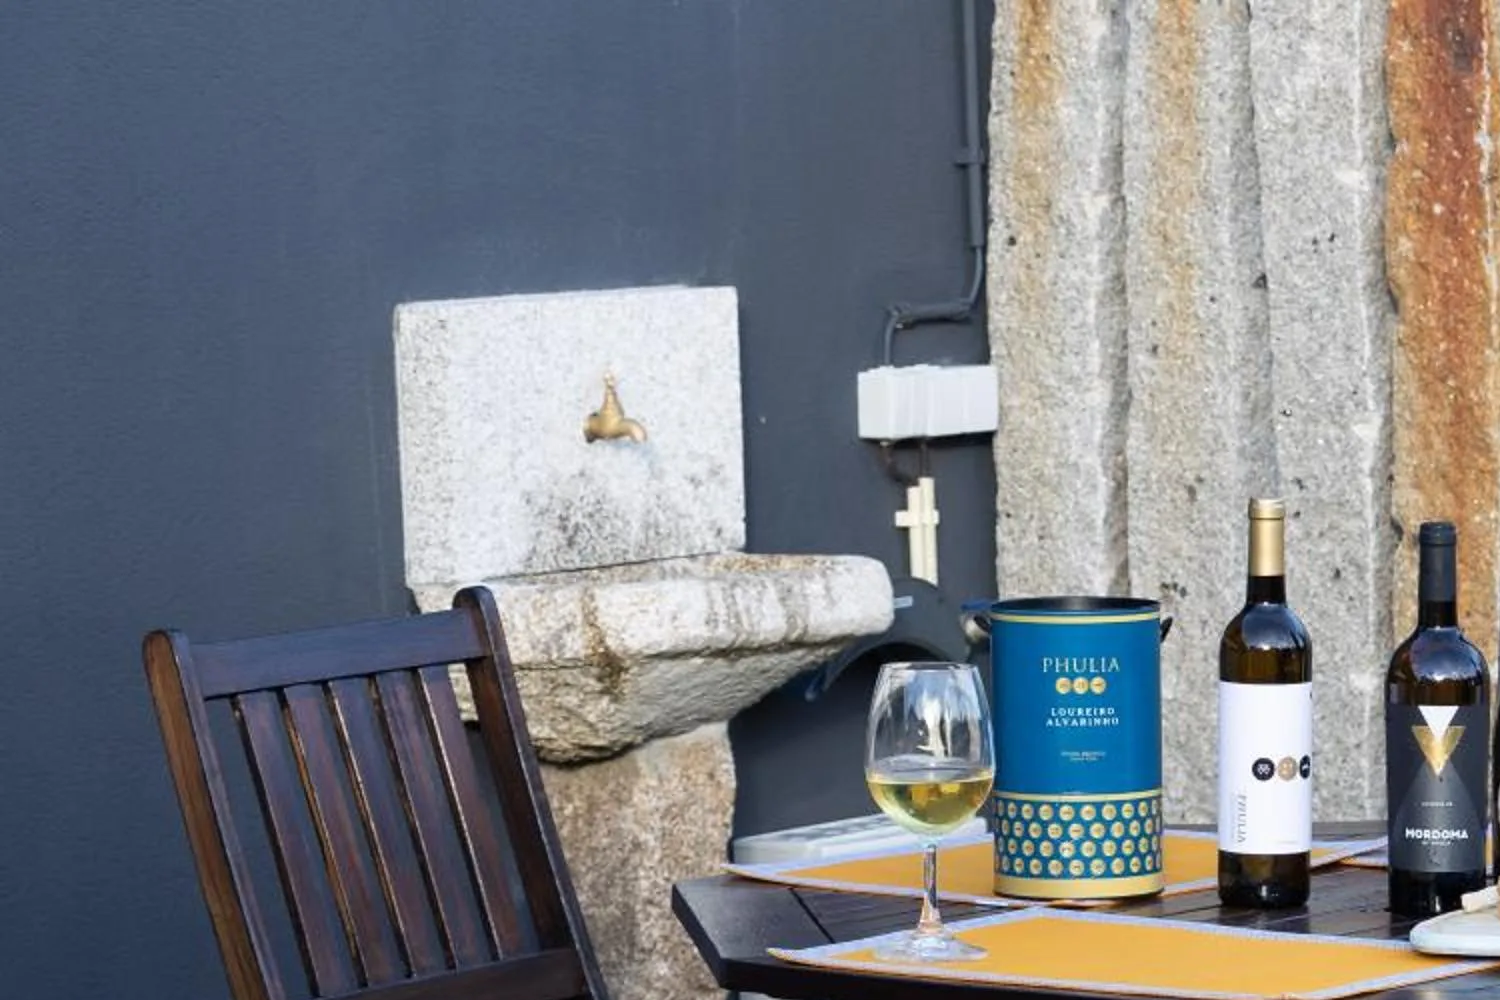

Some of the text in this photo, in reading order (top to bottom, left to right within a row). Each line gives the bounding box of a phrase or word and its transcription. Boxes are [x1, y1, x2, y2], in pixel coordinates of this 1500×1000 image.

[1043, 657, 1120, 673] PHULIA
[1051, 707, 1115, 717] LOUREIRO
[1046, 718, 1119, 727] ALVARINHO
[1405, 828, 1469, 839] MORDOMA
